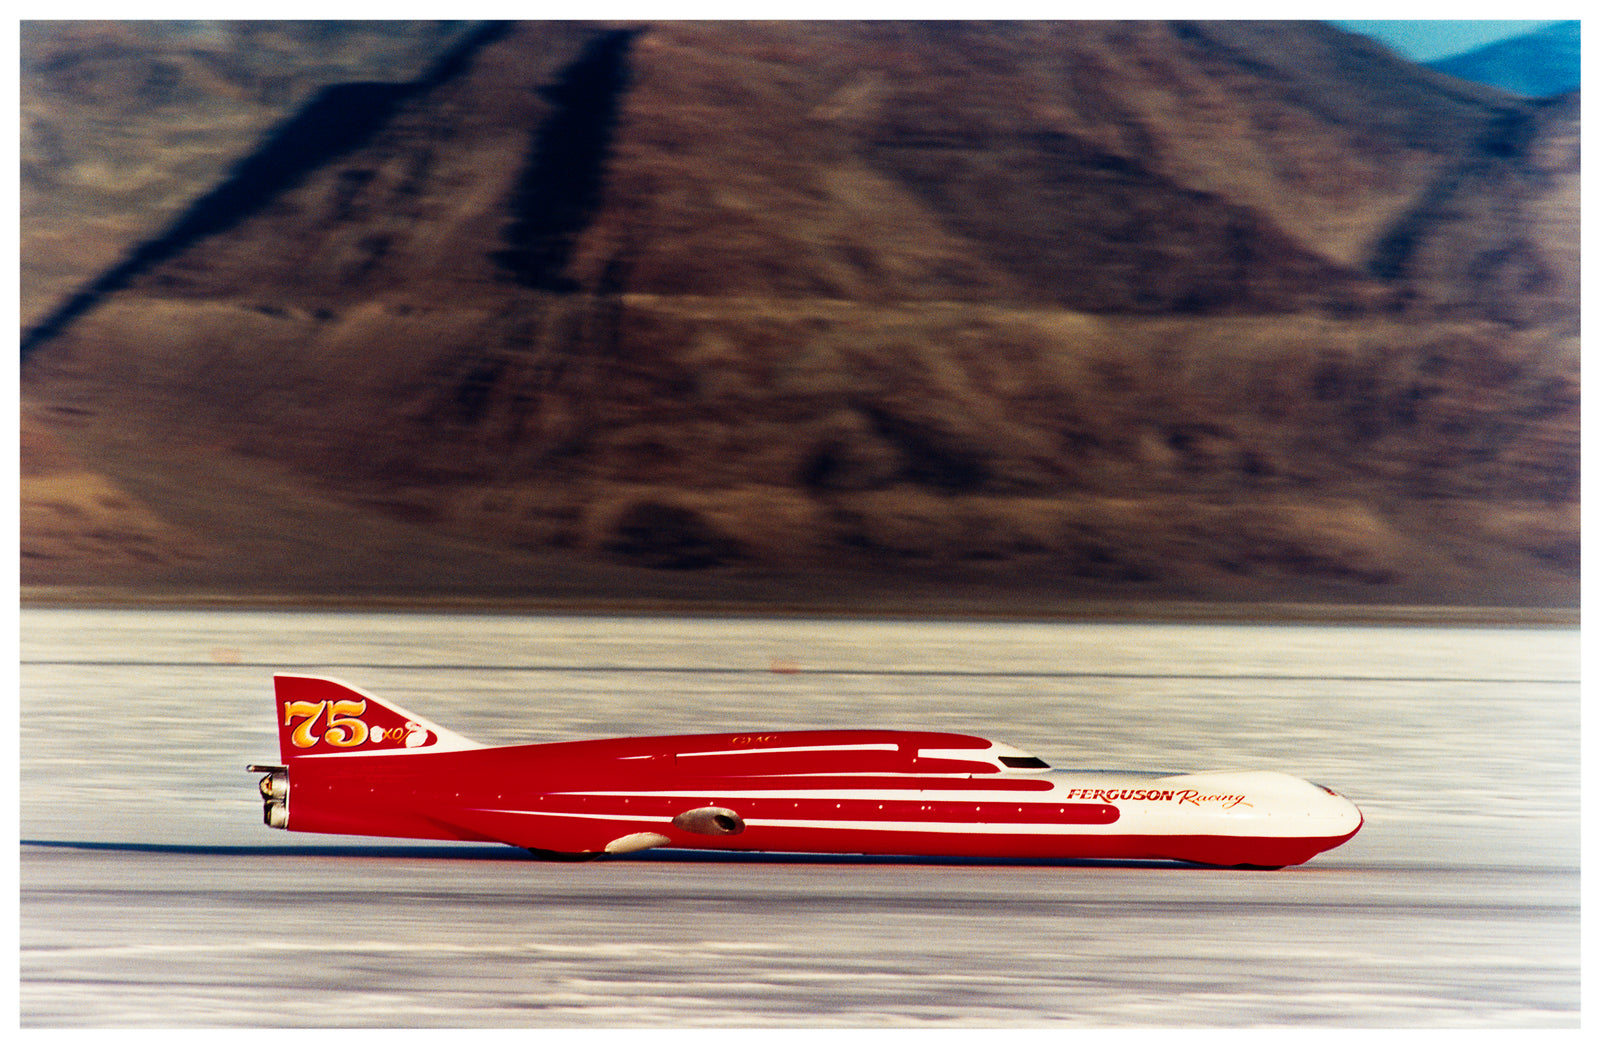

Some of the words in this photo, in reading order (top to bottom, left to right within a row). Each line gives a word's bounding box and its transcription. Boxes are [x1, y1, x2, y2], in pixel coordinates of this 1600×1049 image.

[283, 698, 370, 748] 75
[1066, 788, 1174, 804] FERGUSON
[1176, 789, 1254, 809] Racing
